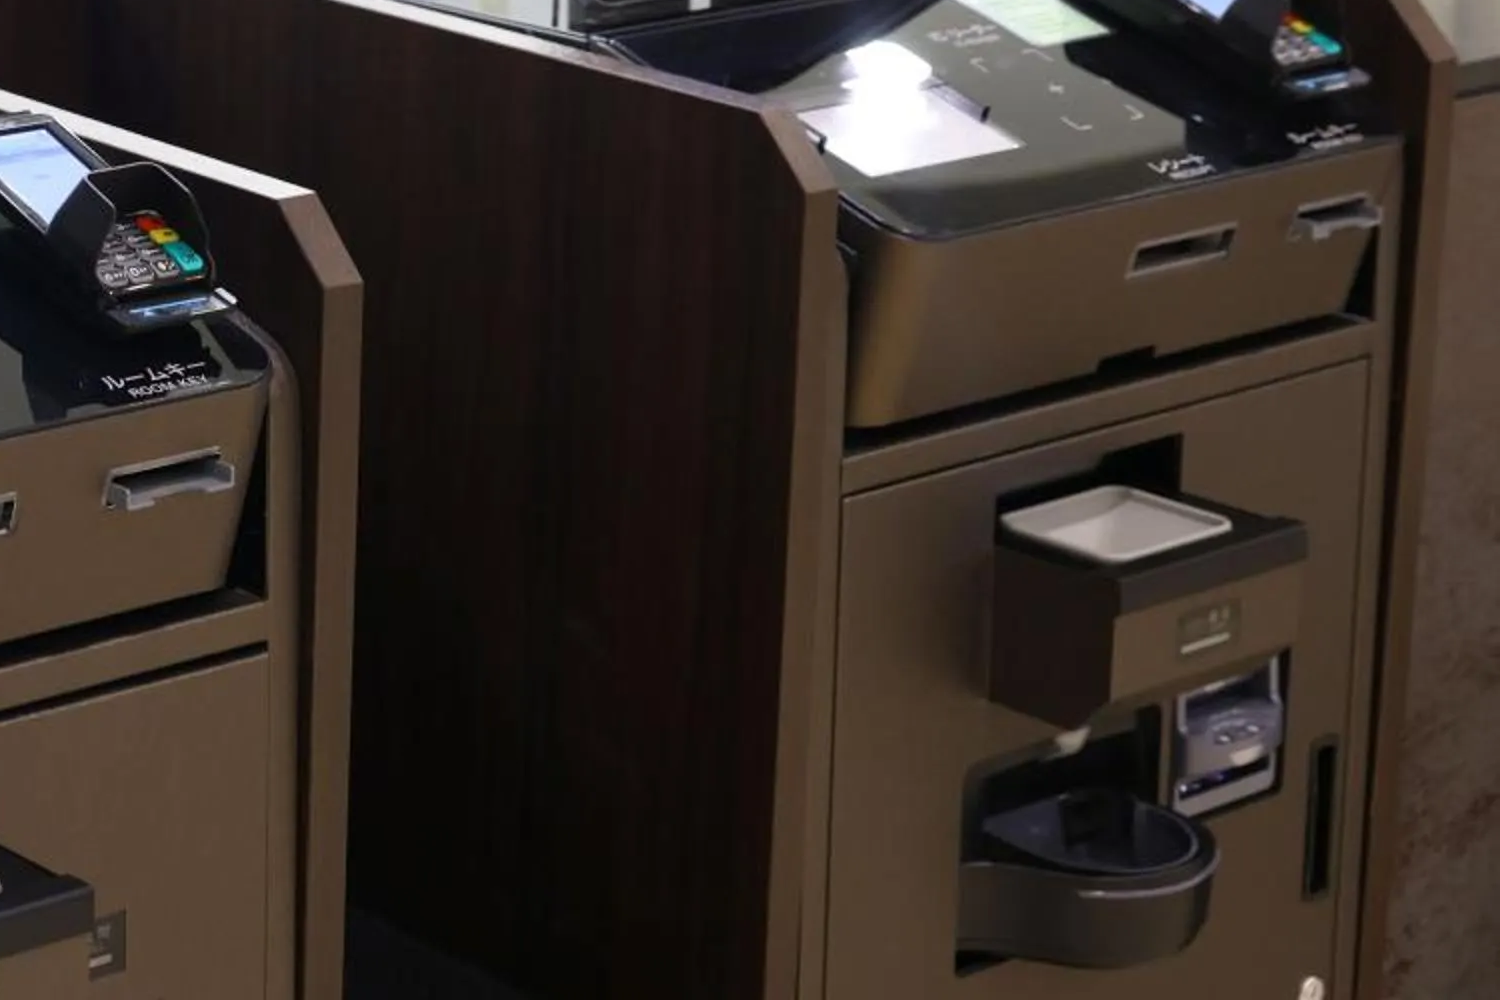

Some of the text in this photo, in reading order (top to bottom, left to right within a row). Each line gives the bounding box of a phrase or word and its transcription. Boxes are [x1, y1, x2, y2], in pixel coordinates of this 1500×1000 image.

[101, 362, 205, 391] ルームキー
[128, 373, 207, 399] ROOM KEY
